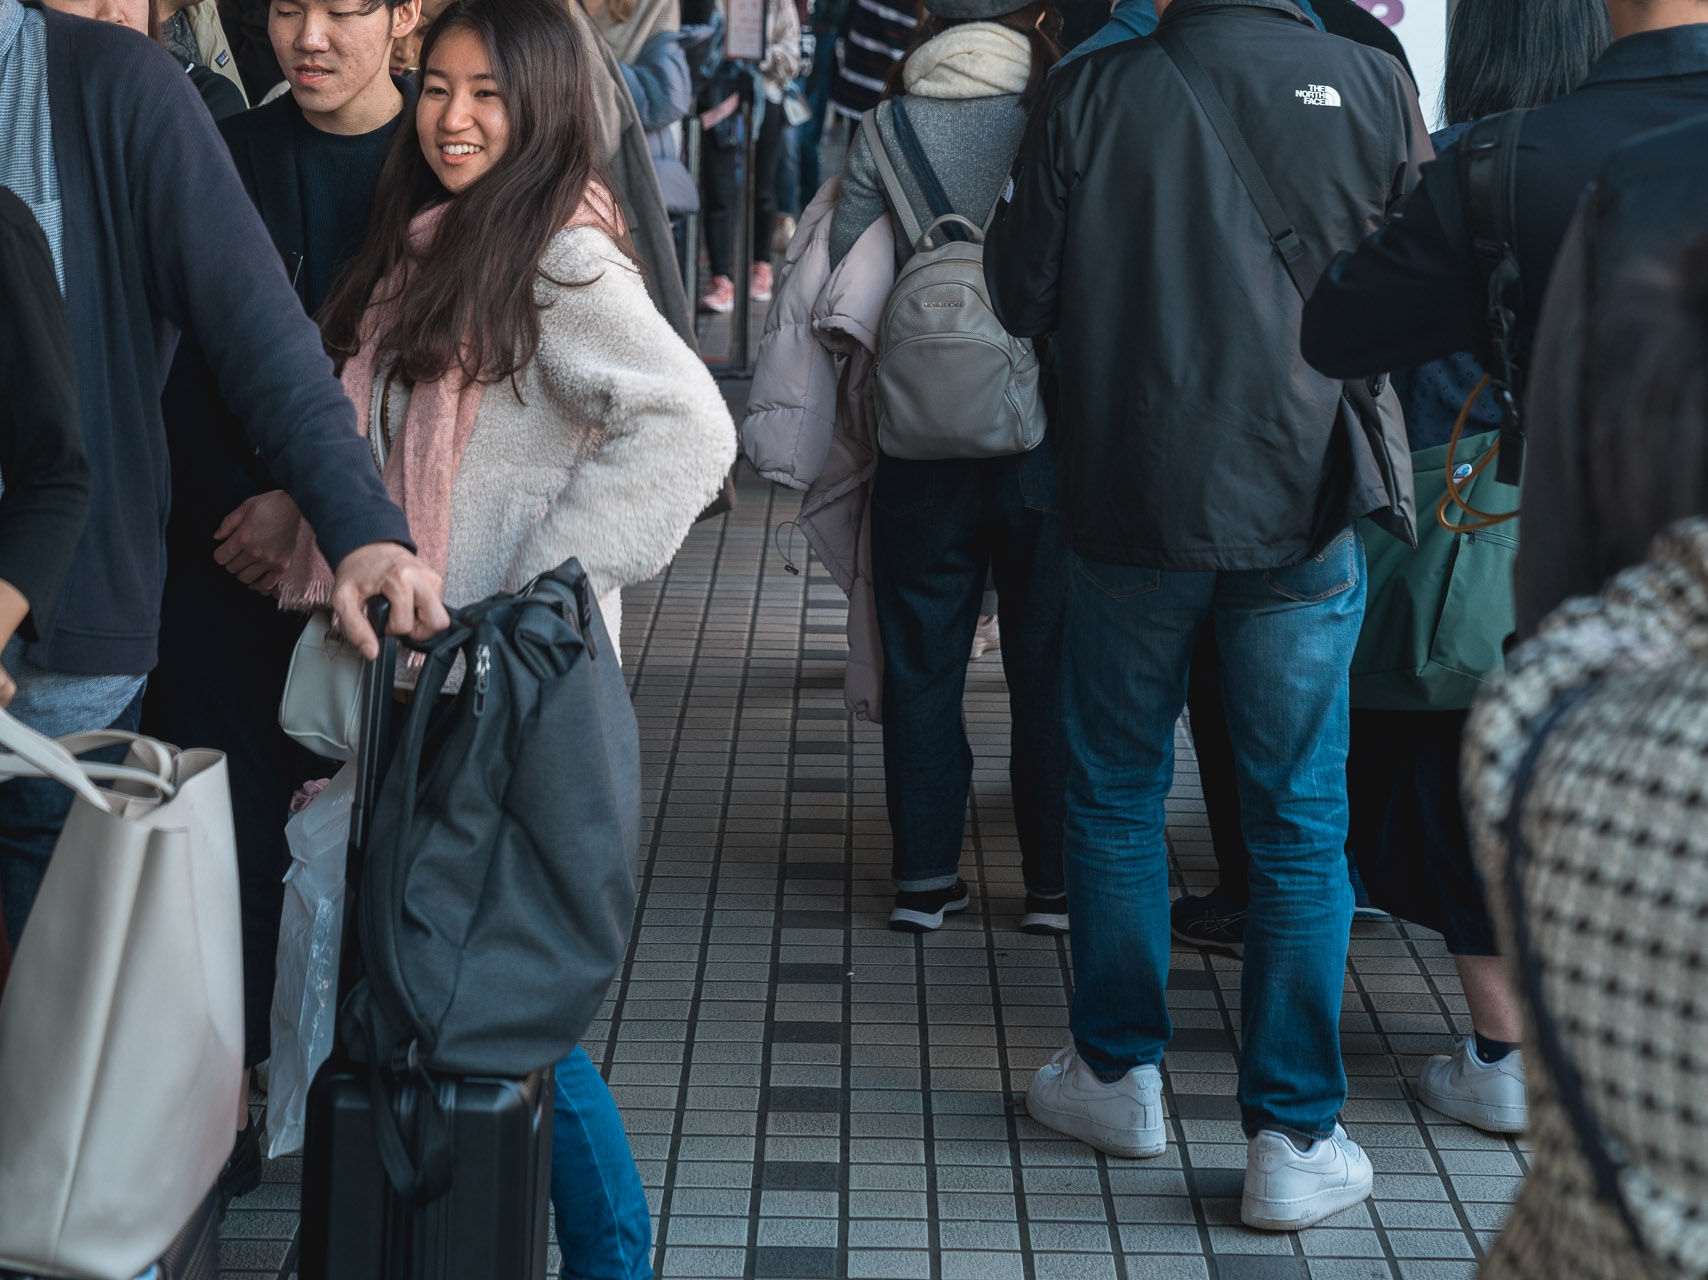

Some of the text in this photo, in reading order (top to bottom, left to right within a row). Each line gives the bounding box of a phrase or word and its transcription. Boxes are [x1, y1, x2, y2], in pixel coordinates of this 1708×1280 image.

[1307, 84, 1326, 92] THE
[1295, 90, 1326, 99] NORTH
[1303, 98, 1326, 106] FACE
